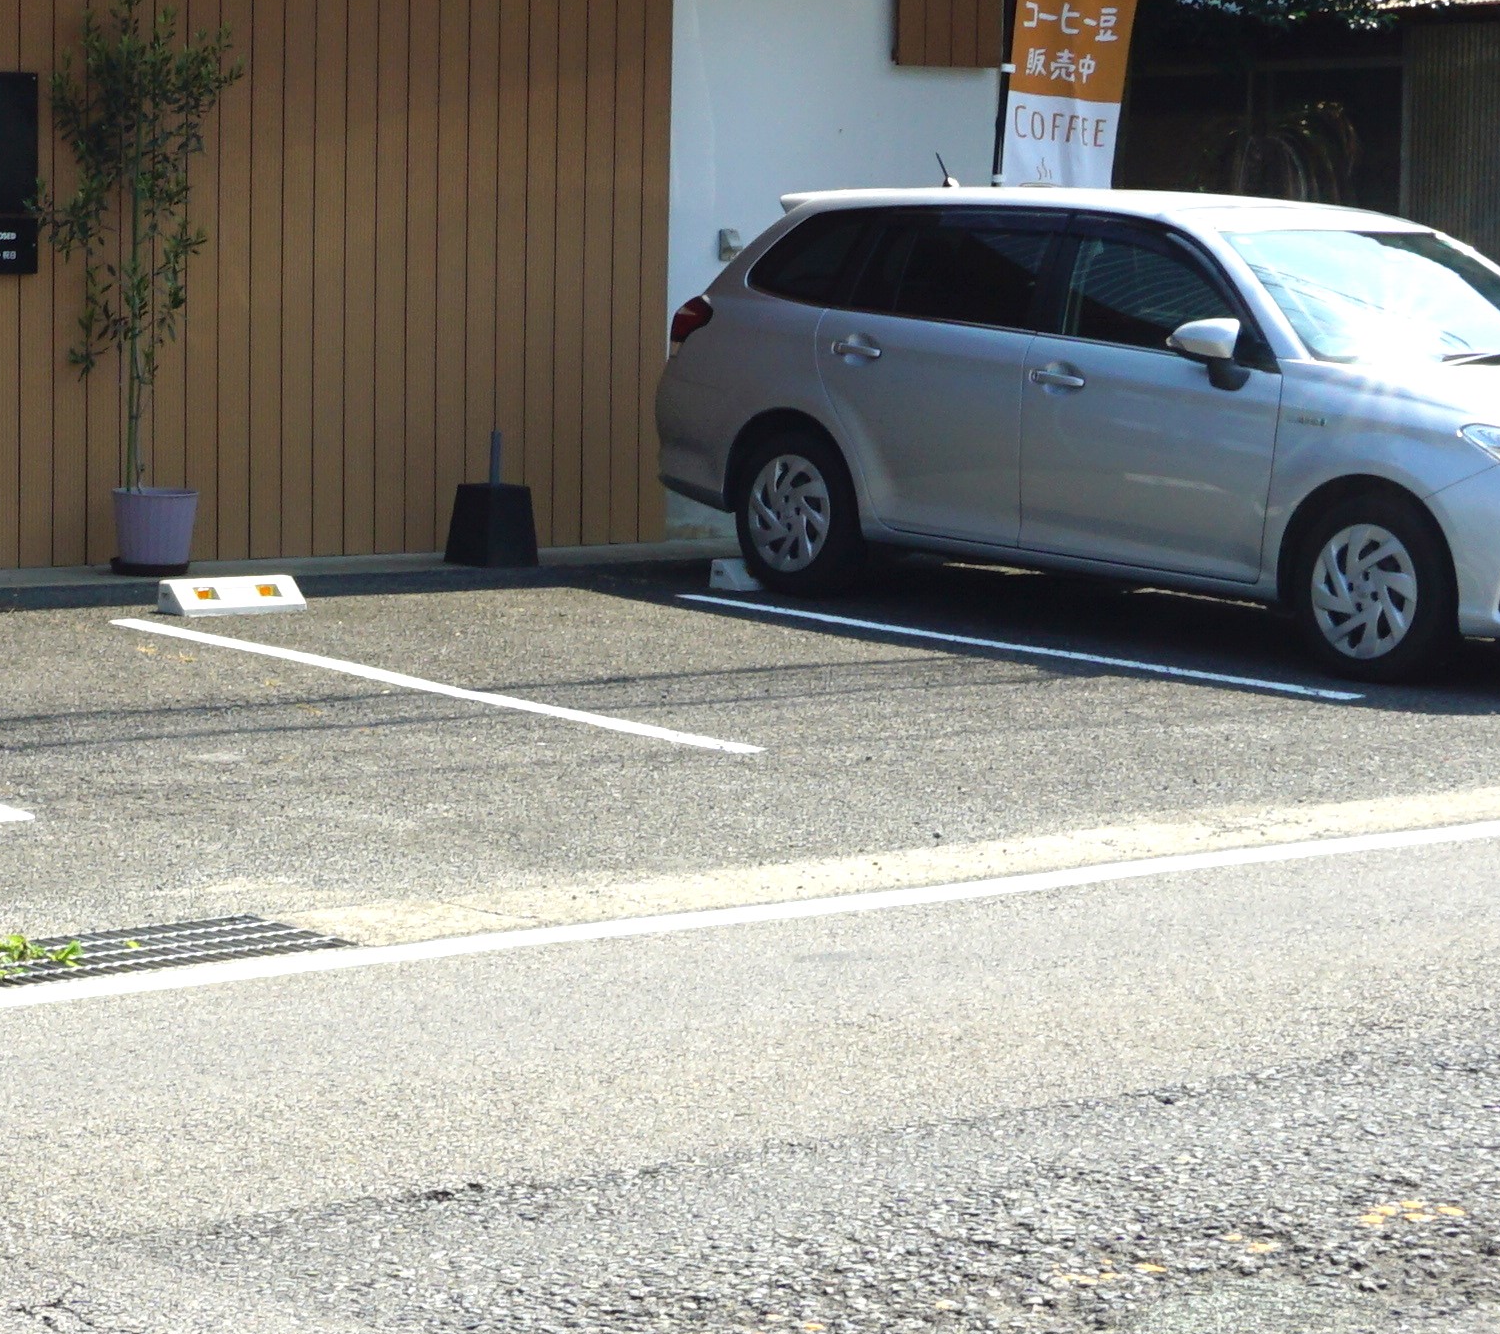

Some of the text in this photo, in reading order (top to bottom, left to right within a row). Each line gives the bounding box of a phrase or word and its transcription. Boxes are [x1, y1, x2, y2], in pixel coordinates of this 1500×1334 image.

[1023, 0, 1119, 42] コーヒー豆
[1025, 47, 1097, 84] 販売中
[1014, 105, 1107, 148] COFFEE
